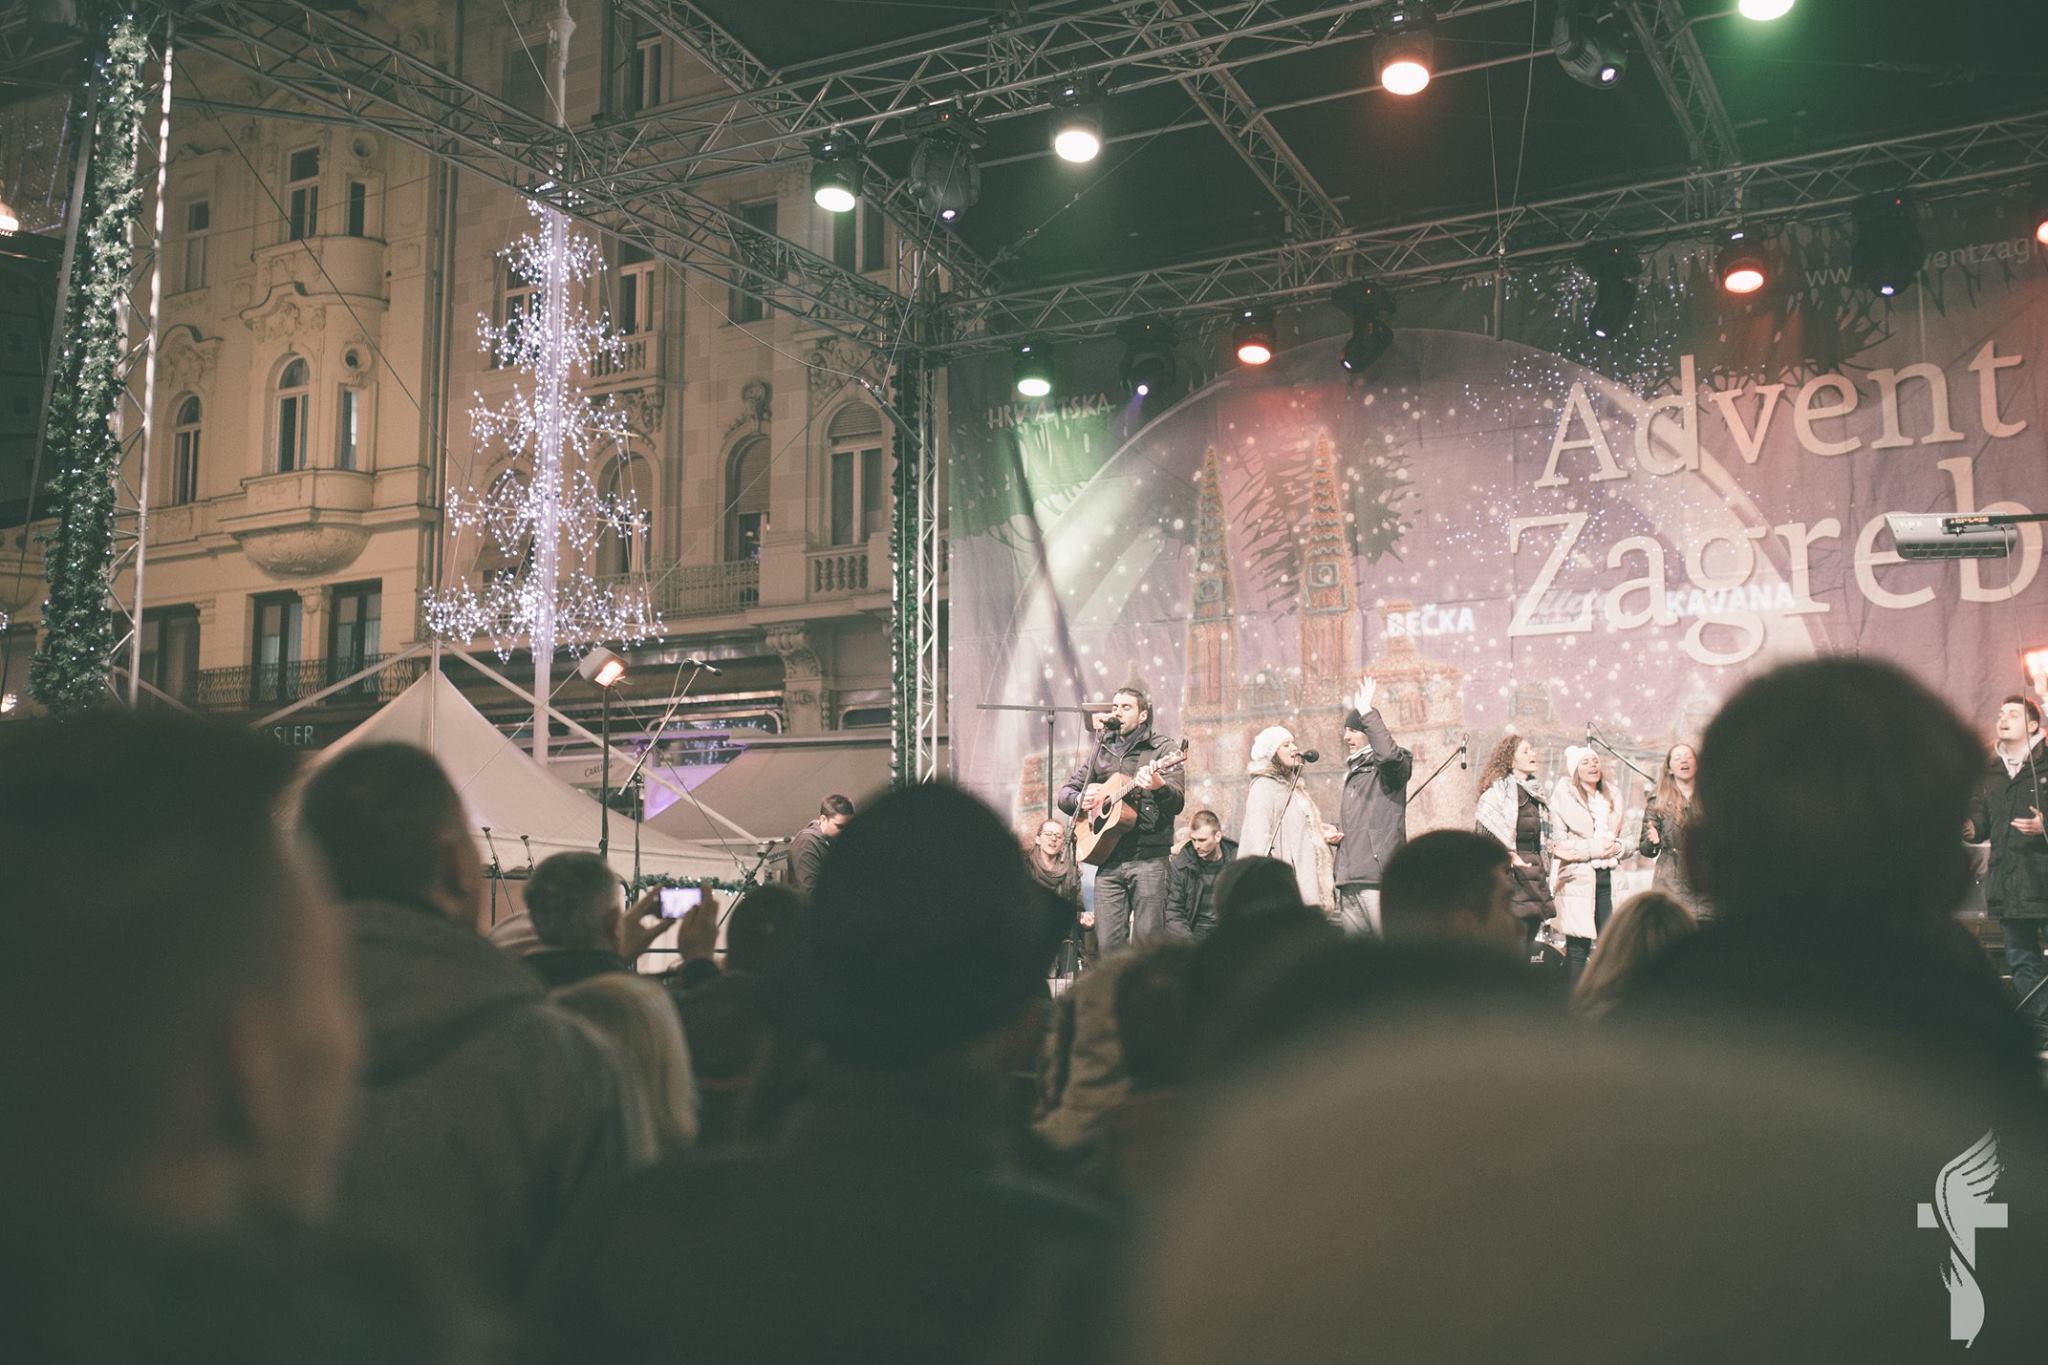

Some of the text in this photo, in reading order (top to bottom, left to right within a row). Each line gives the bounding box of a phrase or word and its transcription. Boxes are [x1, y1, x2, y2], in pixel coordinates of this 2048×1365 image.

[1534, 340, 2027, 488] Advent
[1386, 603, 1476, 637] BEČKA
[1665, 582, 1794, 617] KAVANA
[1507, 456, 2043, 665] Zagreb
